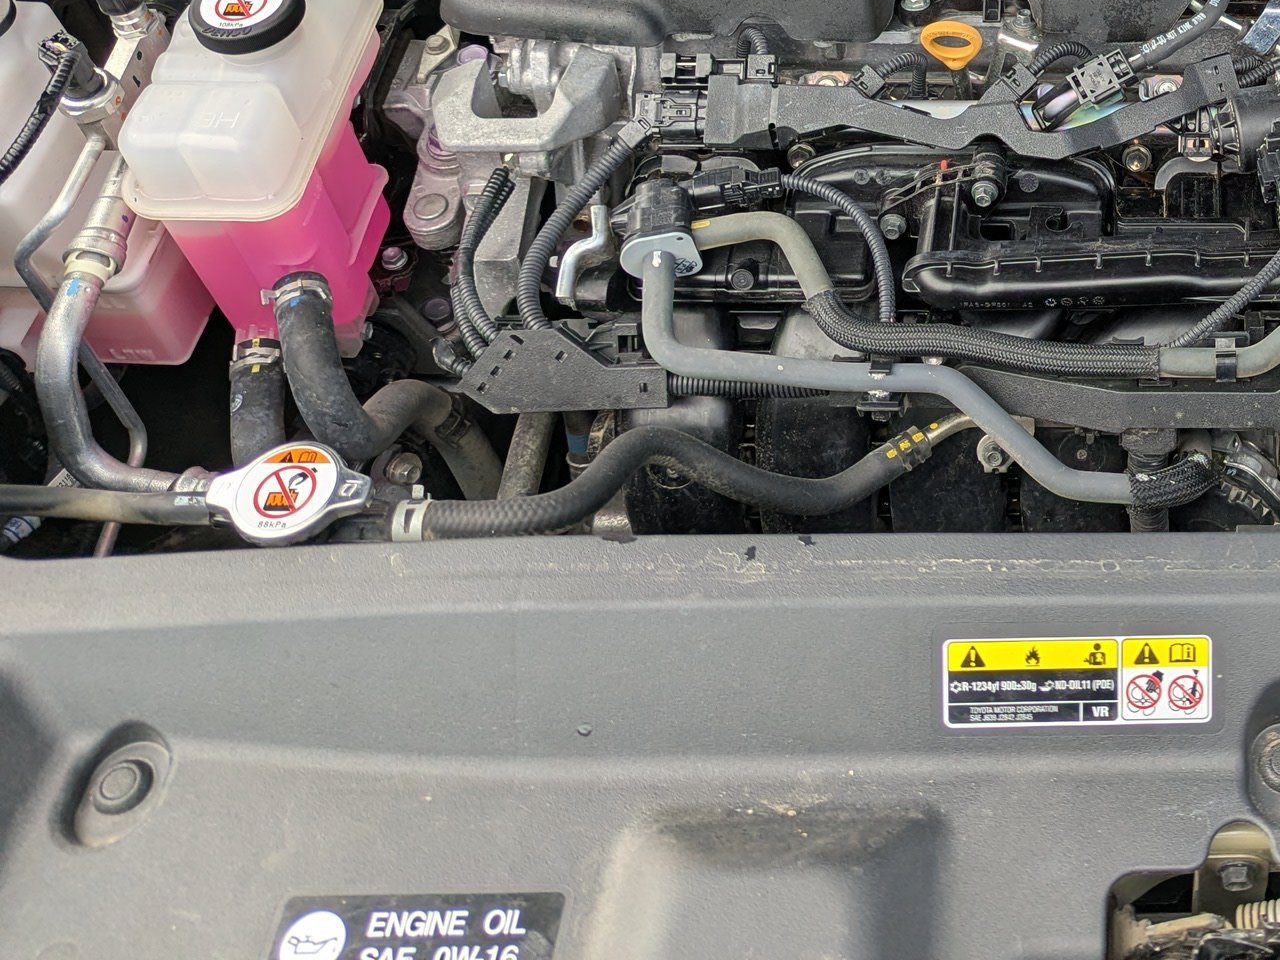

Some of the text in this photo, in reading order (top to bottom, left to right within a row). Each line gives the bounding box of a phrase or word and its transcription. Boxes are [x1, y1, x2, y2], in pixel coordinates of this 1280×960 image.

[257, 521, 287, 529] 88kPa
[962, 680, 1115, 693] R-1234yf 900±30g ND-OIL11 (POE)
[1092, 706, 1109, 717] VR
[970, 714, 982, 722] SAE
[366, 909, 526, 937] ENGINE OIL
